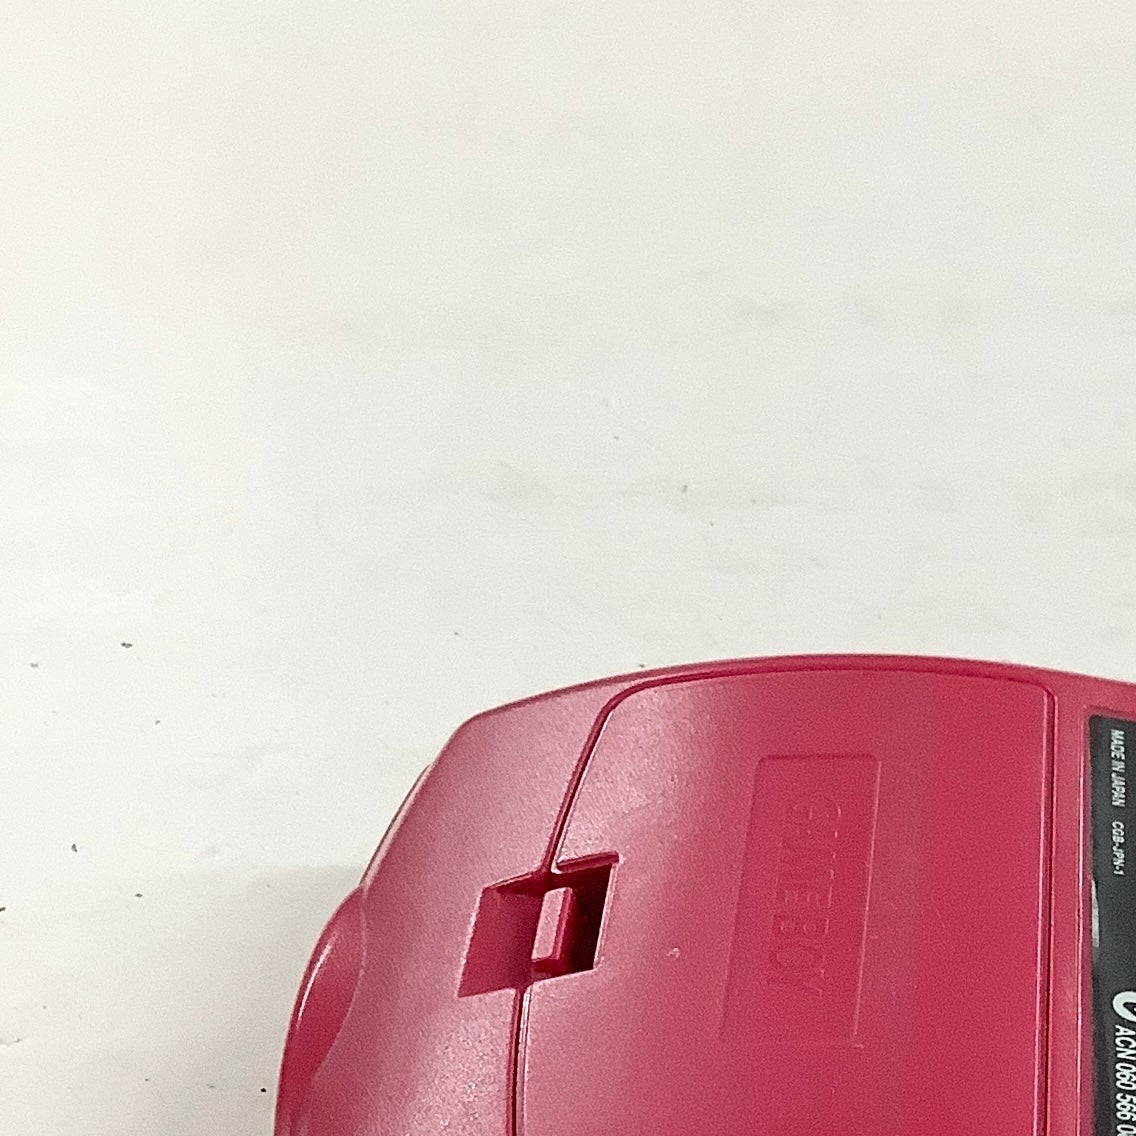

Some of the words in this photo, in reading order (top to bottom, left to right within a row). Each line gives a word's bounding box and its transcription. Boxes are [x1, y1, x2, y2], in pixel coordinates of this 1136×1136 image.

[1111, 729, 1125, 760] MADE
[1112, 760, 1125, 772] IN
[1111, 773, 1125, 807] JAPAN
[1112, 821, 1124, 875] CGB-JPN-1
[1115, 1025, 1136, 1060] ACN
